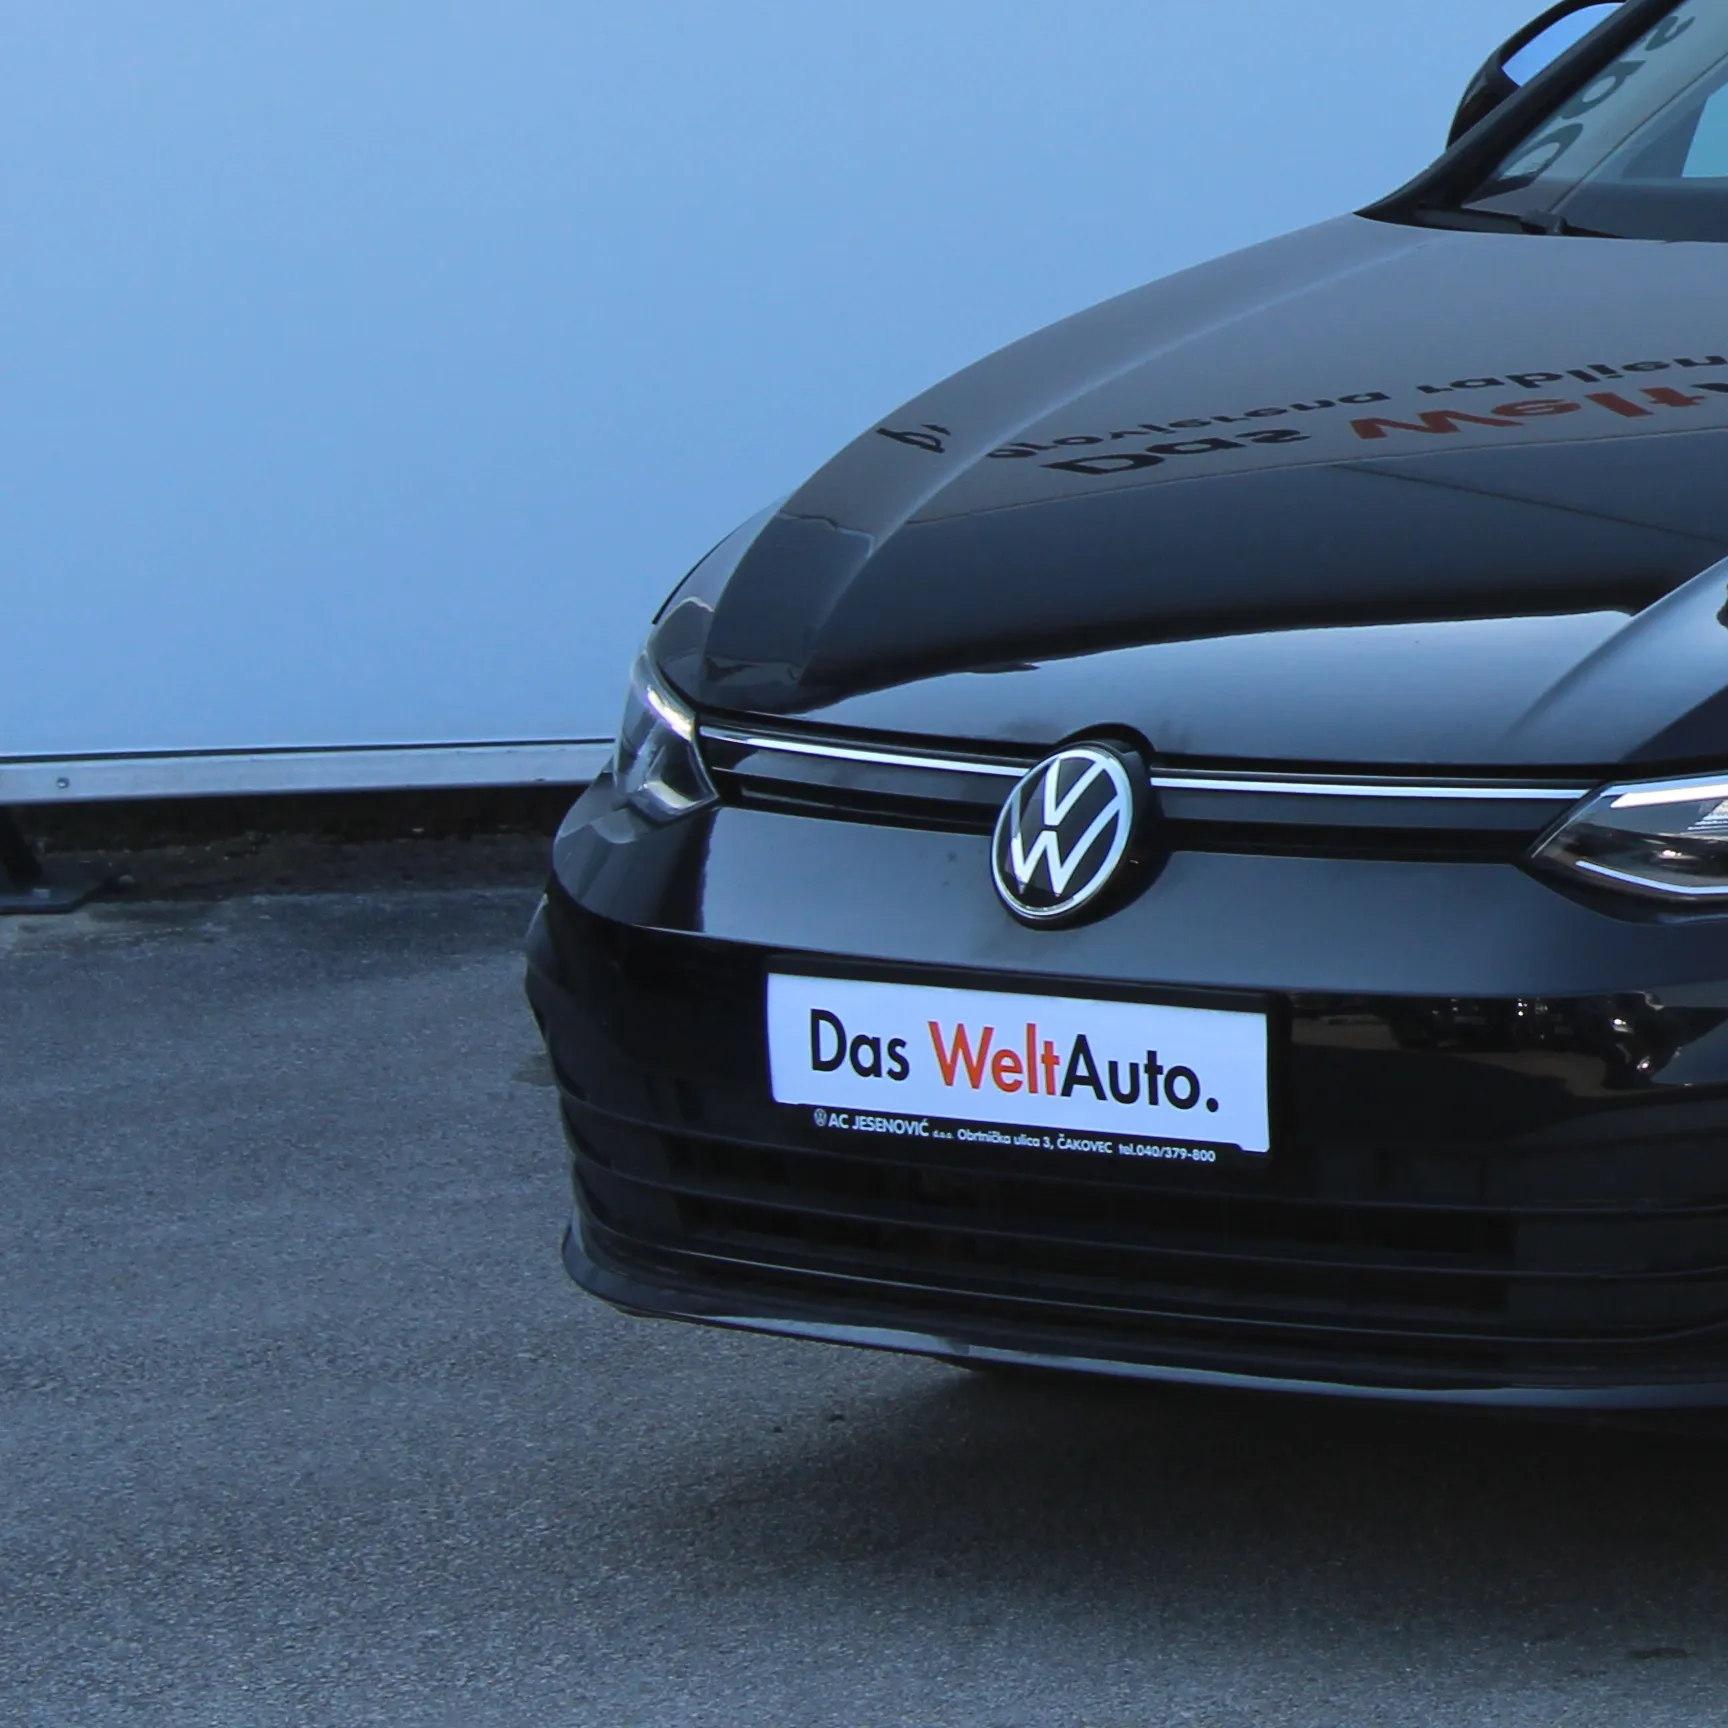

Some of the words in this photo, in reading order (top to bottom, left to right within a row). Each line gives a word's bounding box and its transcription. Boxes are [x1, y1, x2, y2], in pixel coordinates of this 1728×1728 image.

[810, 1008, 911, 1082] Das
[928, 1021, 1220, 1113] WeltAuto.
[828, 1112, 850, 1130] AC
[852, 1114, 930, 1137] JESENOVIĆ
[1014, 1133, 1040, 1148] ulica
[1057, 1133, 1113, 1154] ČAKOVEC
